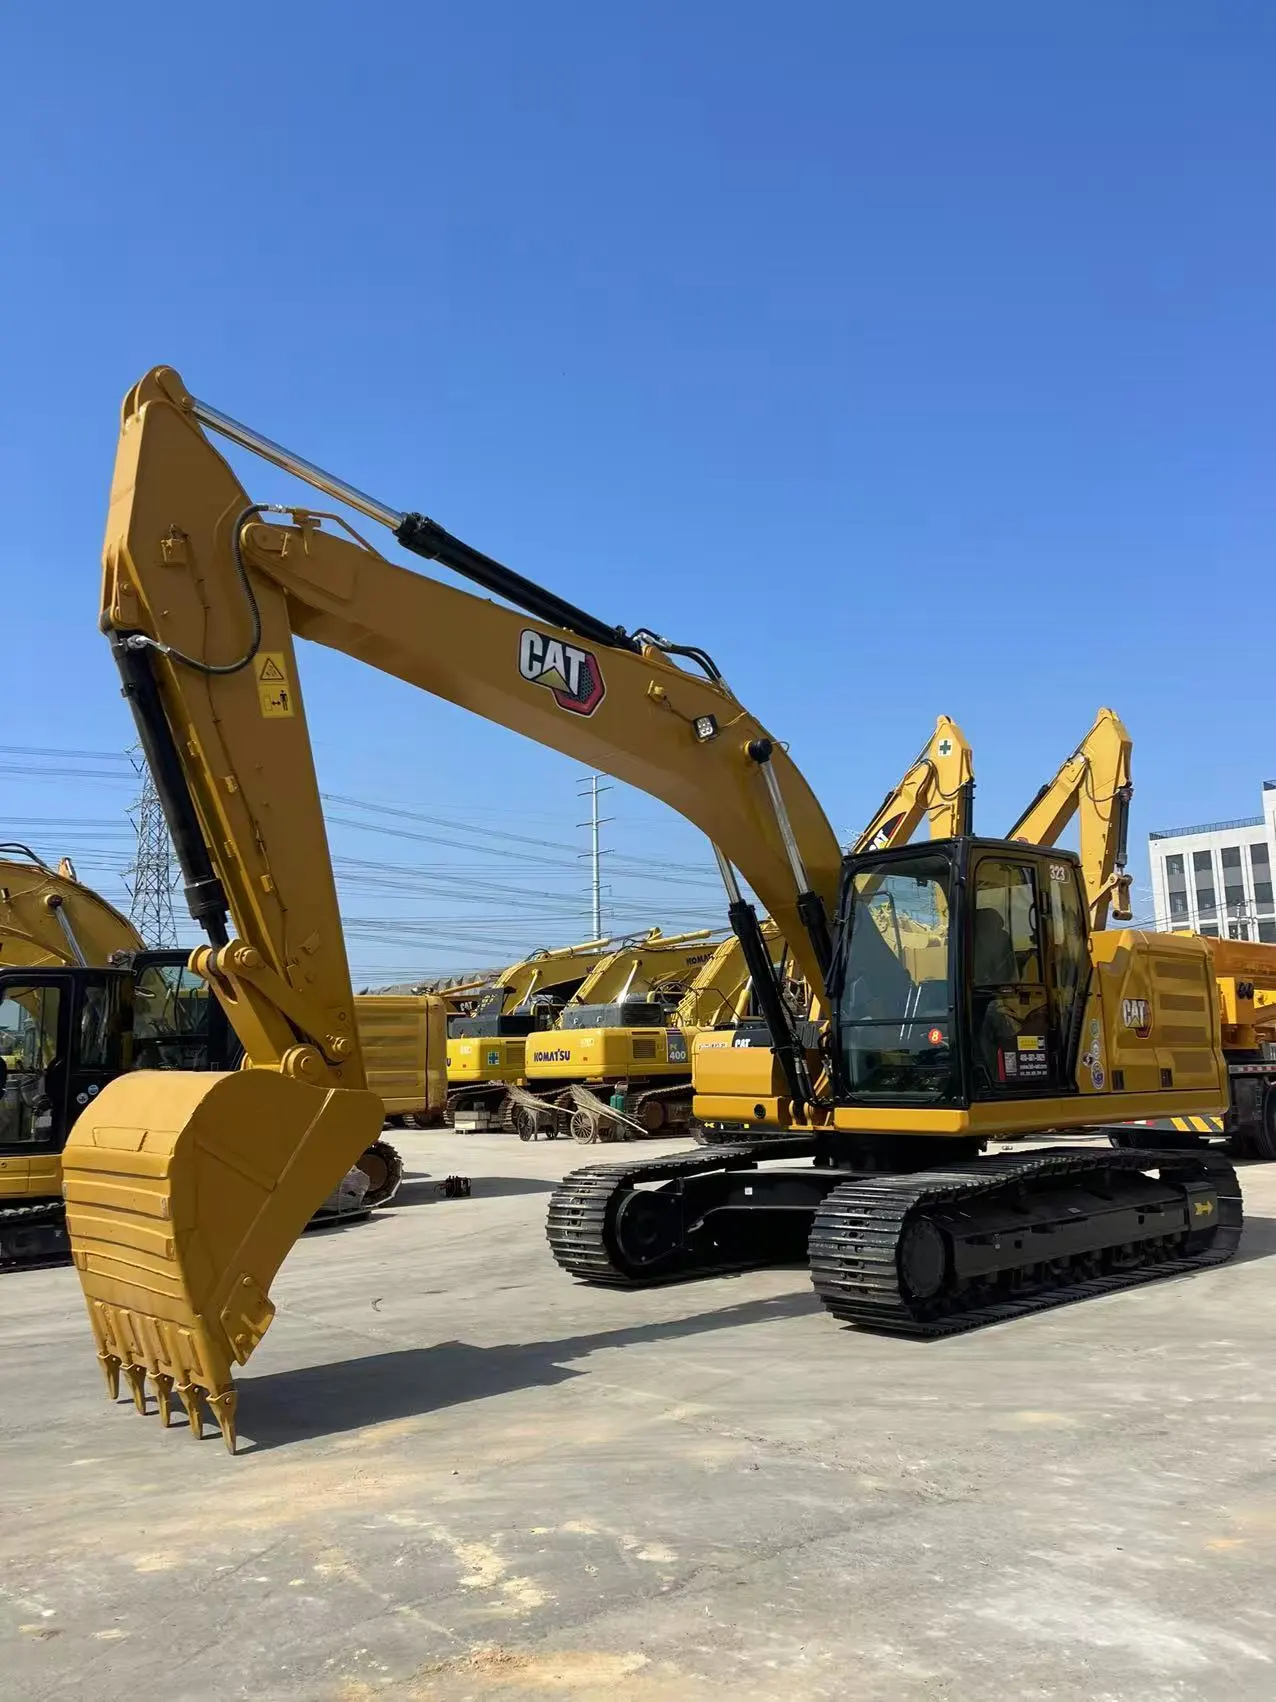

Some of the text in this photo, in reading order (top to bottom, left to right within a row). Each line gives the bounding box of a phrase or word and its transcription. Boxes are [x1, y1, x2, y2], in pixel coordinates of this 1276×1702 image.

[520, 630, 586, 696] CAT
[1050, 864, 1065, 881] 323
[460, 1001, 473, 1012] CAT
[1123, 999, 1145, 1028] CAT
[734, 1038, 751, 1048] CAT
[533, 1048, 571, 1062] KOMATSU
[669, 1051, 686, 1060] 400
